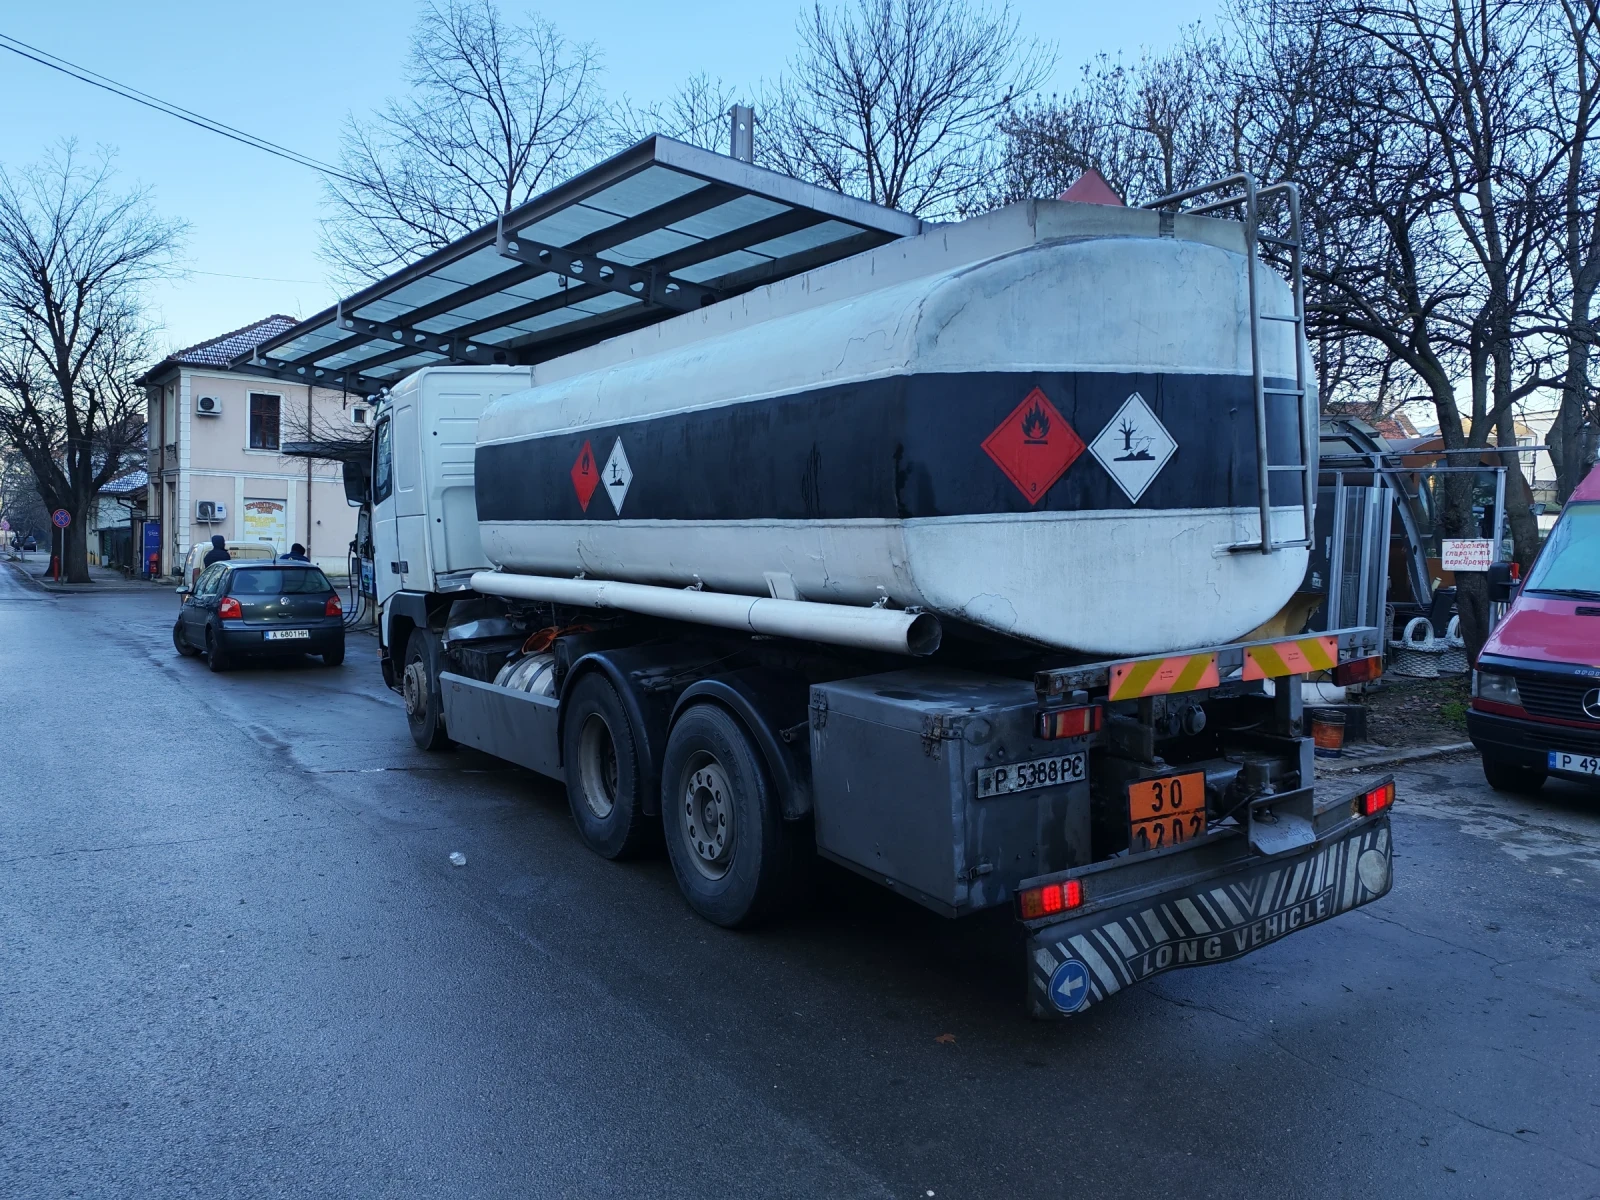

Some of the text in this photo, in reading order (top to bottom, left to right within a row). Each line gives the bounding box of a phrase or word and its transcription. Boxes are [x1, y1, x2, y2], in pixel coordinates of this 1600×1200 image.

[1031, 483, 1037, 492] 3
[1579, 758, 1600, 773] 49
[1151, 779, 1183, 812] 30
[1142, 896, 1327, 976] LONG VEHICLE
